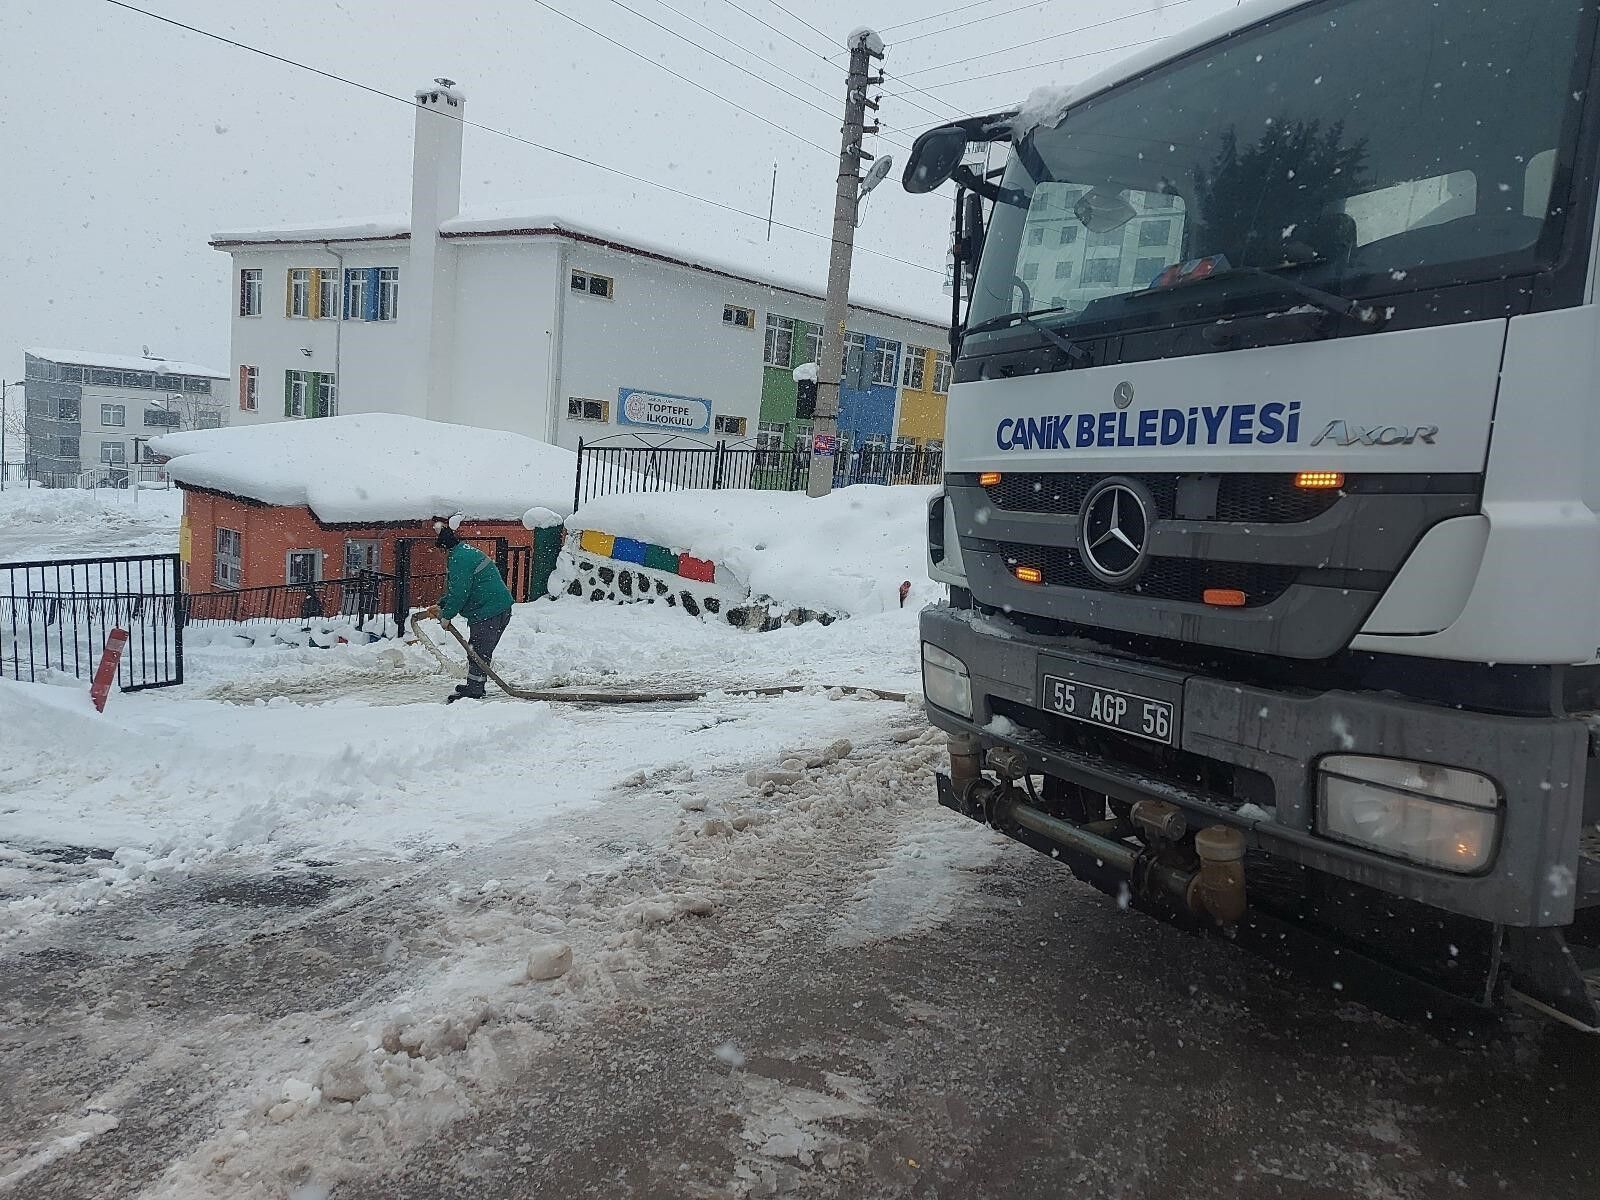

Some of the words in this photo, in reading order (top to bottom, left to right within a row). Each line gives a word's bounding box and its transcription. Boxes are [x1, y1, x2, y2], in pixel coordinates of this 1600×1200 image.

[646, 411, 693, 427] İLKOKULU
[648, 403, 689, 416] TOPTEPE
[1076, 401, 1301, 448] BELEDİYESİ
[1054, 682, 1075, 713] 55
[1090, 691, 1127, 725] AGP
[1142, 703, 1169, 737] 56
